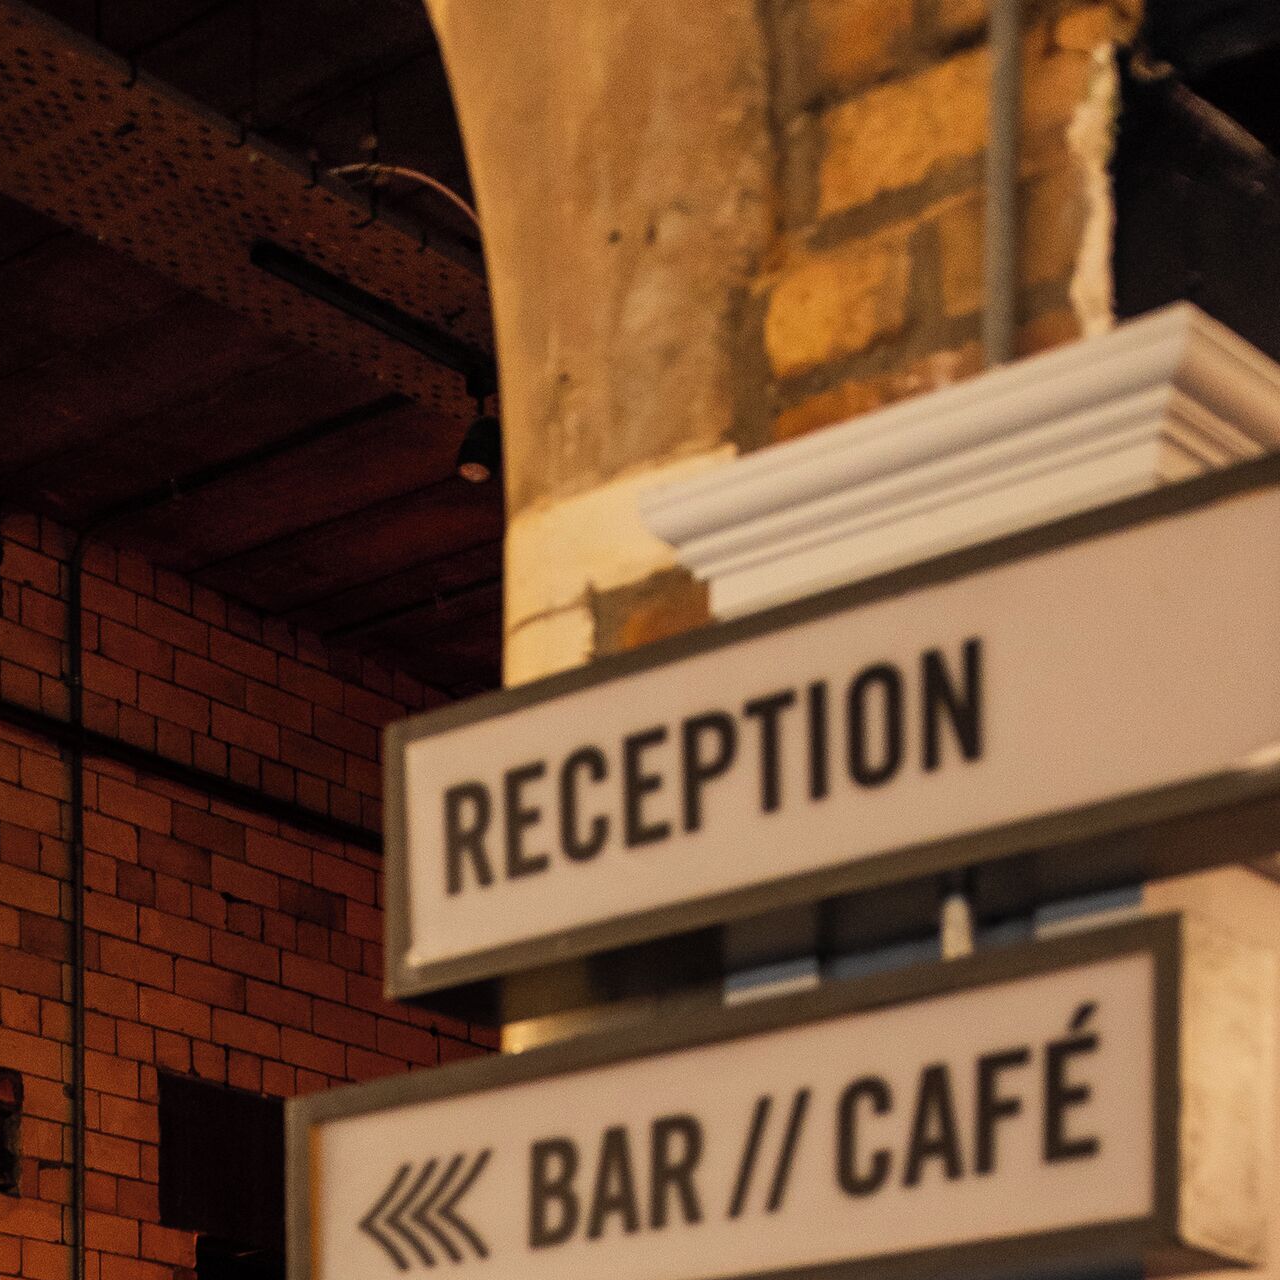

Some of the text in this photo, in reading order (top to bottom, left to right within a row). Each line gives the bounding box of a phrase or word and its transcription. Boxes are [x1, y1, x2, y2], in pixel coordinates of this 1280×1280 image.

[442, 637, 987, 898] RECEPTION
[526, 1112, 705, 1252] BAR
[834, 1002, 1103, 1201] CAFÉ
